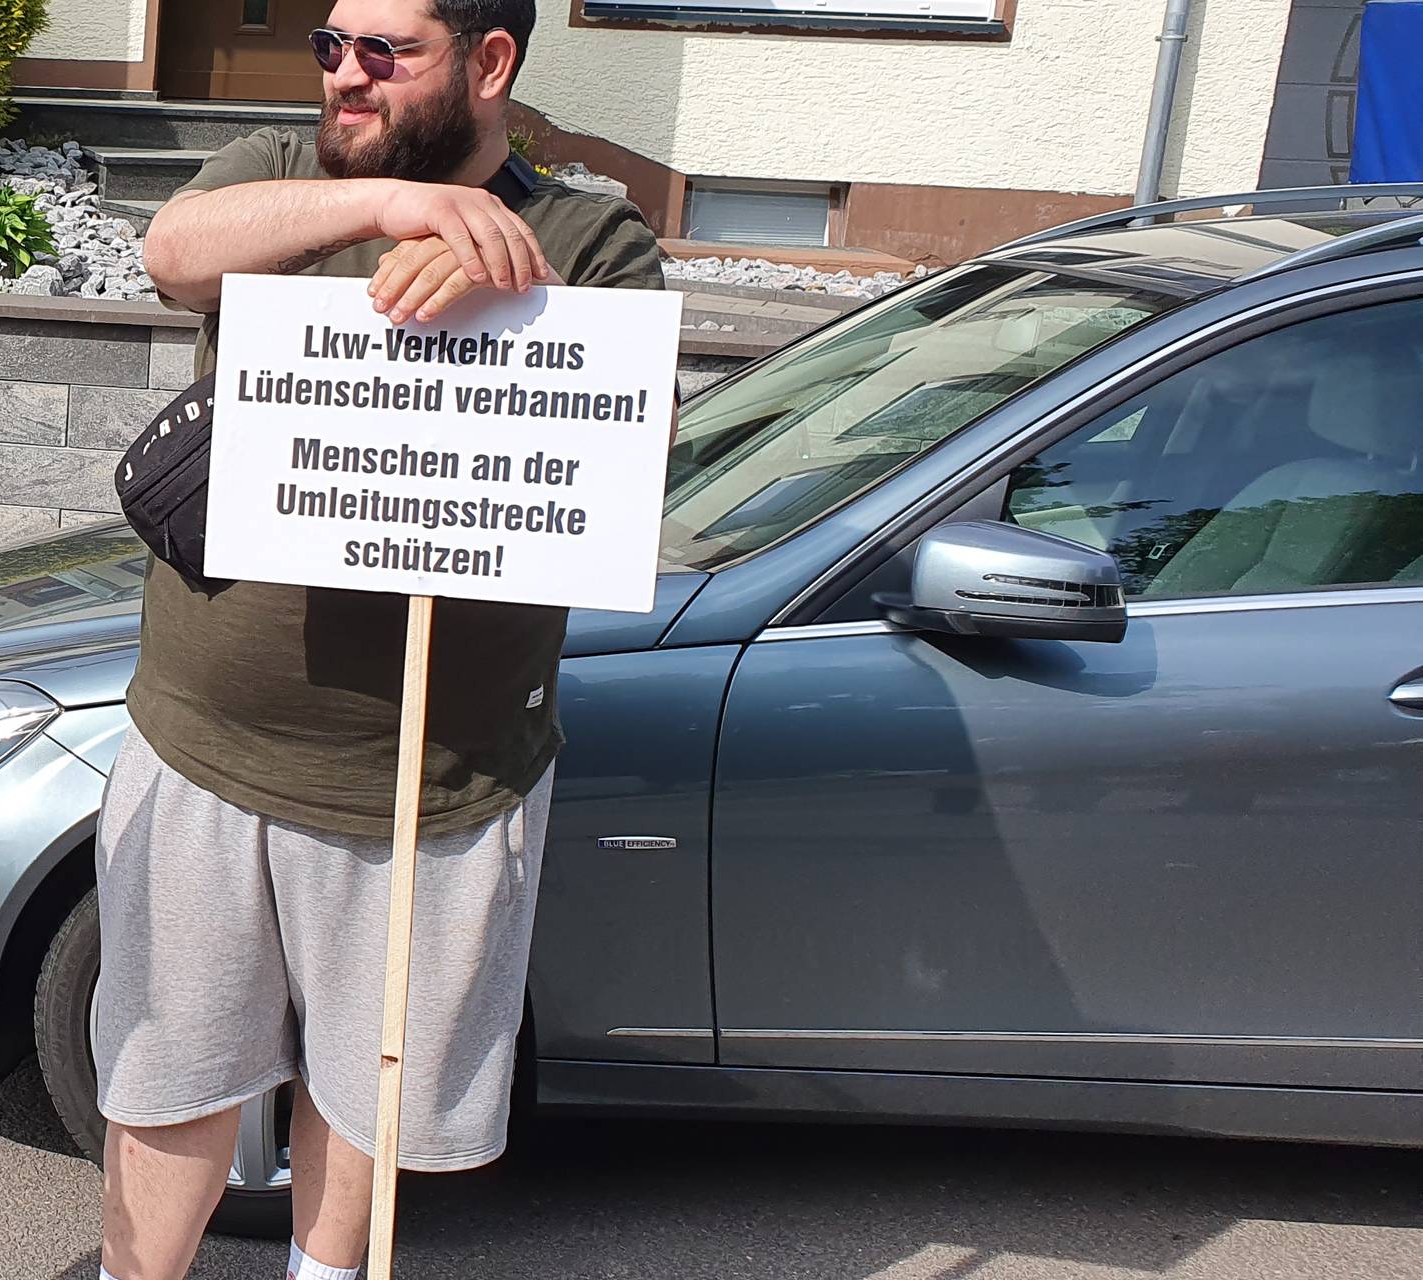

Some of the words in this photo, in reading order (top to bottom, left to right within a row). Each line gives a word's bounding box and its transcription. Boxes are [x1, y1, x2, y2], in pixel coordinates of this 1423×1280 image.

[303, 325, 515, 367] Lkw-Verkehr
[524, 340, 585, 371] aus
[238, 369, 444, 412] Lüdenscheid
[455, 383, 647, 423] verbannen!
[291, 437, 459, 479] Menschen
[471, 454, 512, 482] an
[523, 451, 580, 486] der
[276, 483, 586, 536] Umleitungsstrecke
[344, 537, 504, 577] schützen!
